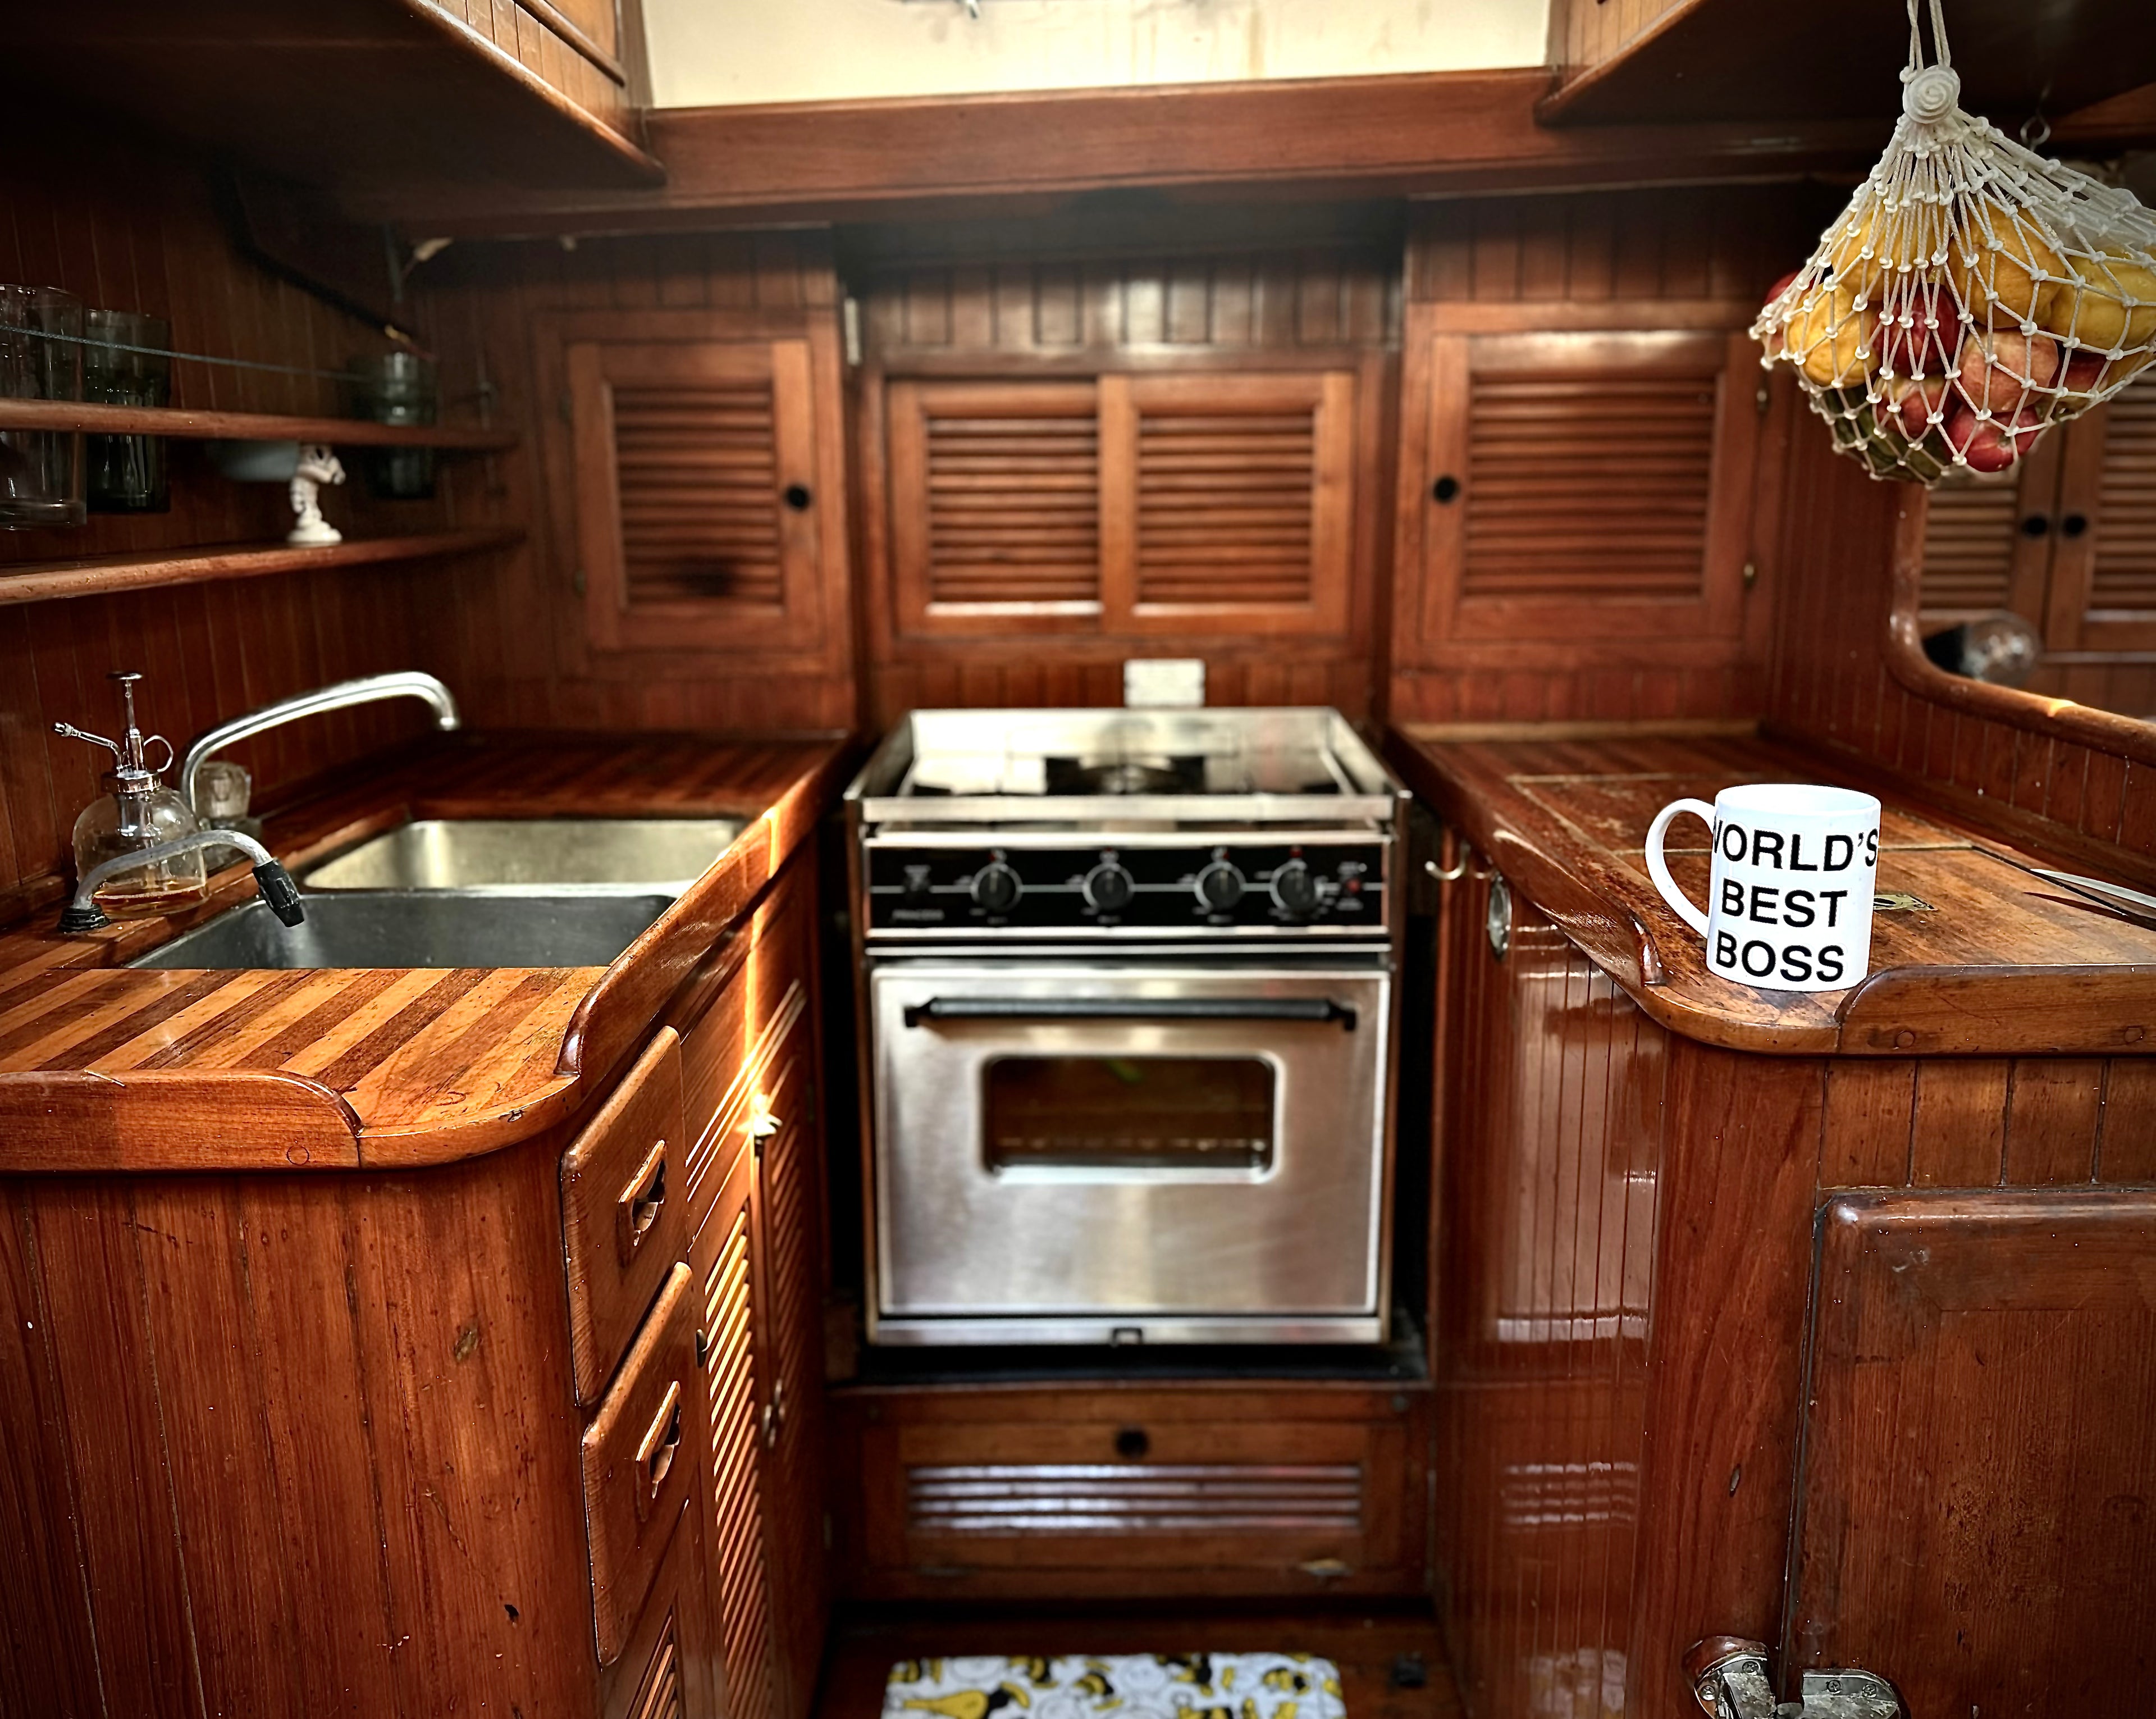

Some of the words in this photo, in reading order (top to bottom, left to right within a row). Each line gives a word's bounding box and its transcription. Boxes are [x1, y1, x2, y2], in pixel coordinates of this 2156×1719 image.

[1713, 815, 1879, 872] WORLD'S
[1721, 878, 1848, 928] BEST
[1716, 930, 1844, 982] BOSS
